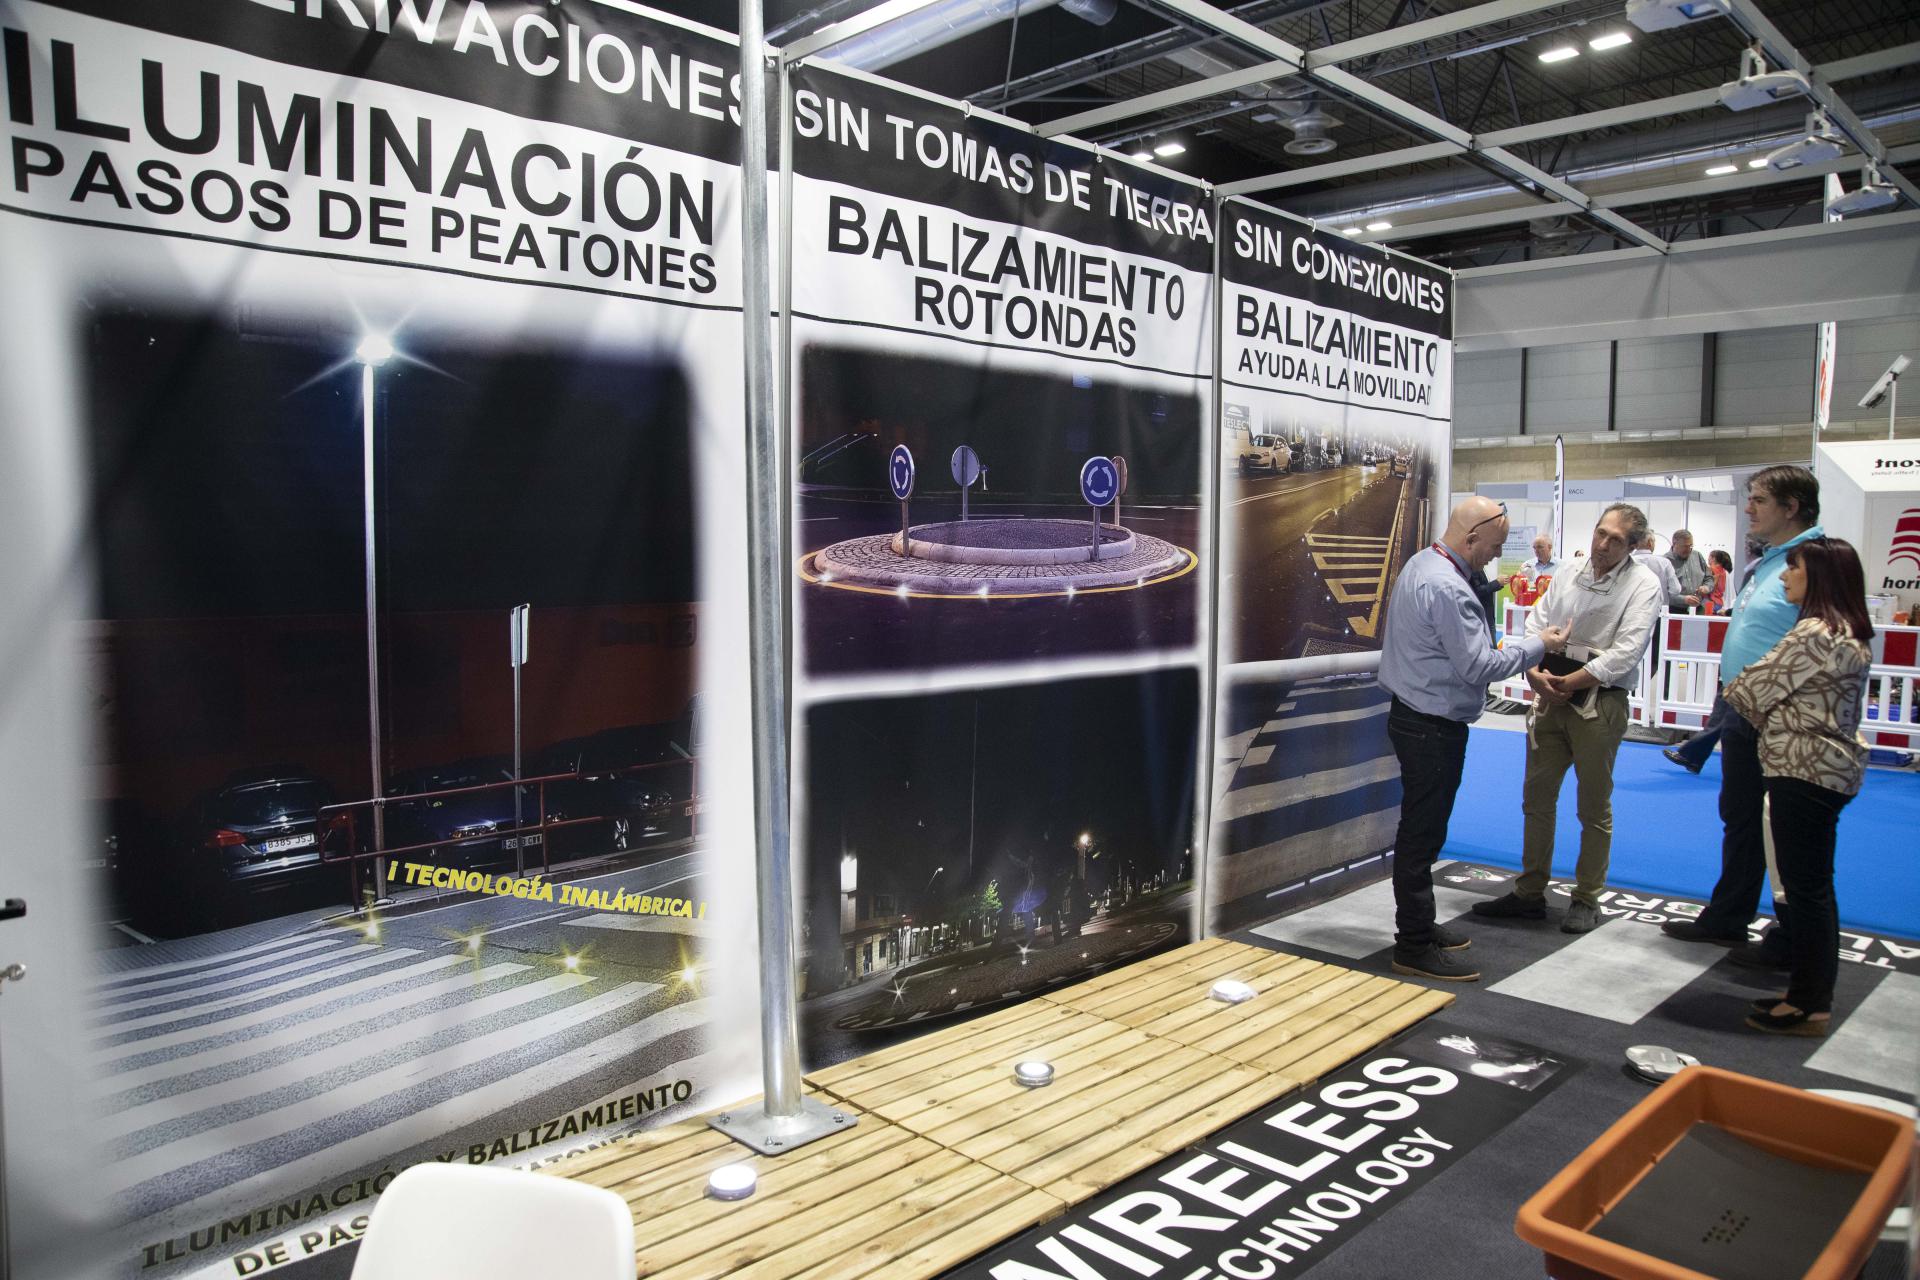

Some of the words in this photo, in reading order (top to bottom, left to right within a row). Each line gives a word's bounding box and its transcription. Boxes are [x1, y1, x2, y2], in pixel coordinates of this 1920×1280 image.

[250, 0, 741, 127] IVACIONE
[3, 27, 714, 246] ILUMINACIÓN
[795, 90, 870, 152] SIN
[886, 115, 1034, 195] TOMAS
[1045, 163, 1091, 211] DE
[1104, 177, 1215, 246] TIERRA
[12, 137, 292, 232] PASOS
[319, 191, 408, 249] DE
[432, 209, 718, 295] PEATONES
[828, 196, 1185, 322] BALIZAMIENTO
[1234, 218, 1283, 268] SIN
[1292, 237, 1445, 315] CONEXIONES
[915, 277, 1137, 358] ROTONDAS
[1236, 294, 1438, 377] BALIZAMIENTO
[1238, 347, 1309, 384] AYUDA
[1326, 364, 1350, 392] LA
[404, 863, 554, 903] TECNOLOGÍA
[558, 885, 693, 920] INALÁMBRICA
[142, 1161, 422, 1270] ILUMINACIÓ
[468, 1080, 693, 1166] BALIZAMIENTO
[233, 1241, 291, 1277] DE
[299, 1215, 370, 1254] PAS
